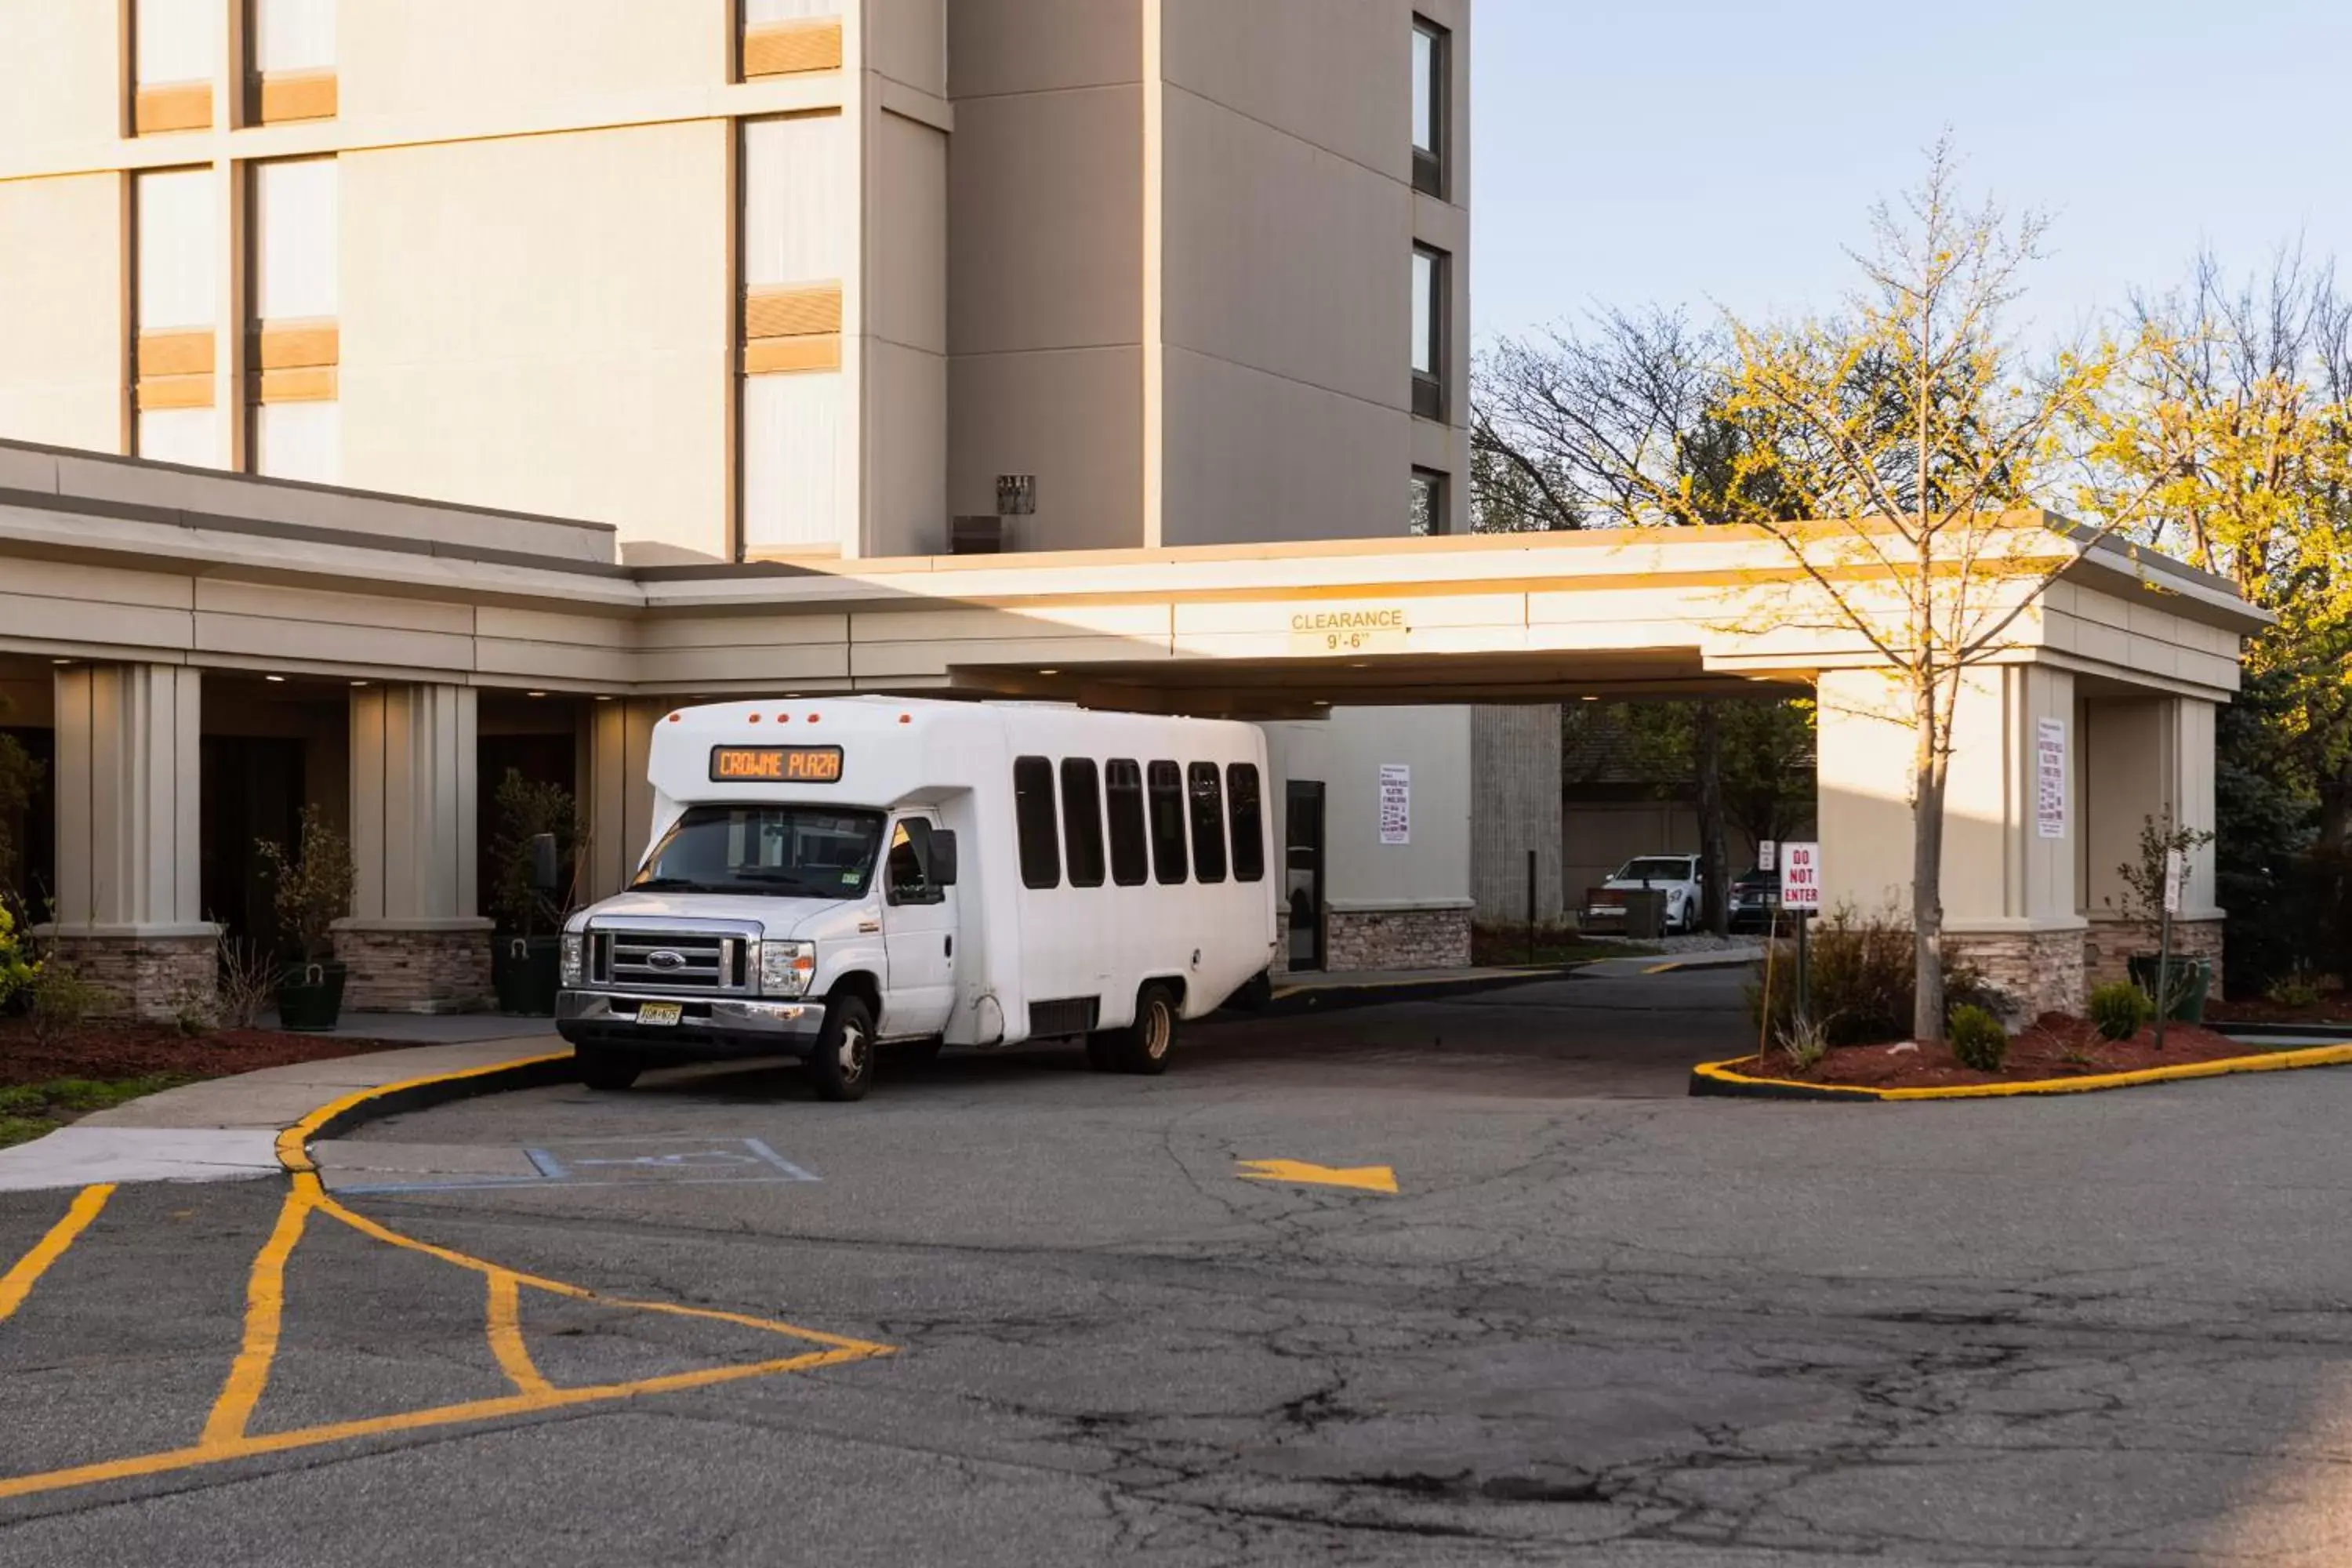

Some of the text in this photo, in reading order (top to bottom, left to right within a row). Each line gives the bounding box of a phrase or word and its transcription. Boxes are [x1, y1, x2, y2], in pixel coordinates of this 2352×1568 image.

[1291, 610, 1403, 630] CLEARANCE
[720, 751, 840, 778] CROWNE PLAZA
[1793, 849, 1809, 865] DO
[1790, 868, 1813, 884] NOT
[1785, 888, 1818, 902] ENTER
